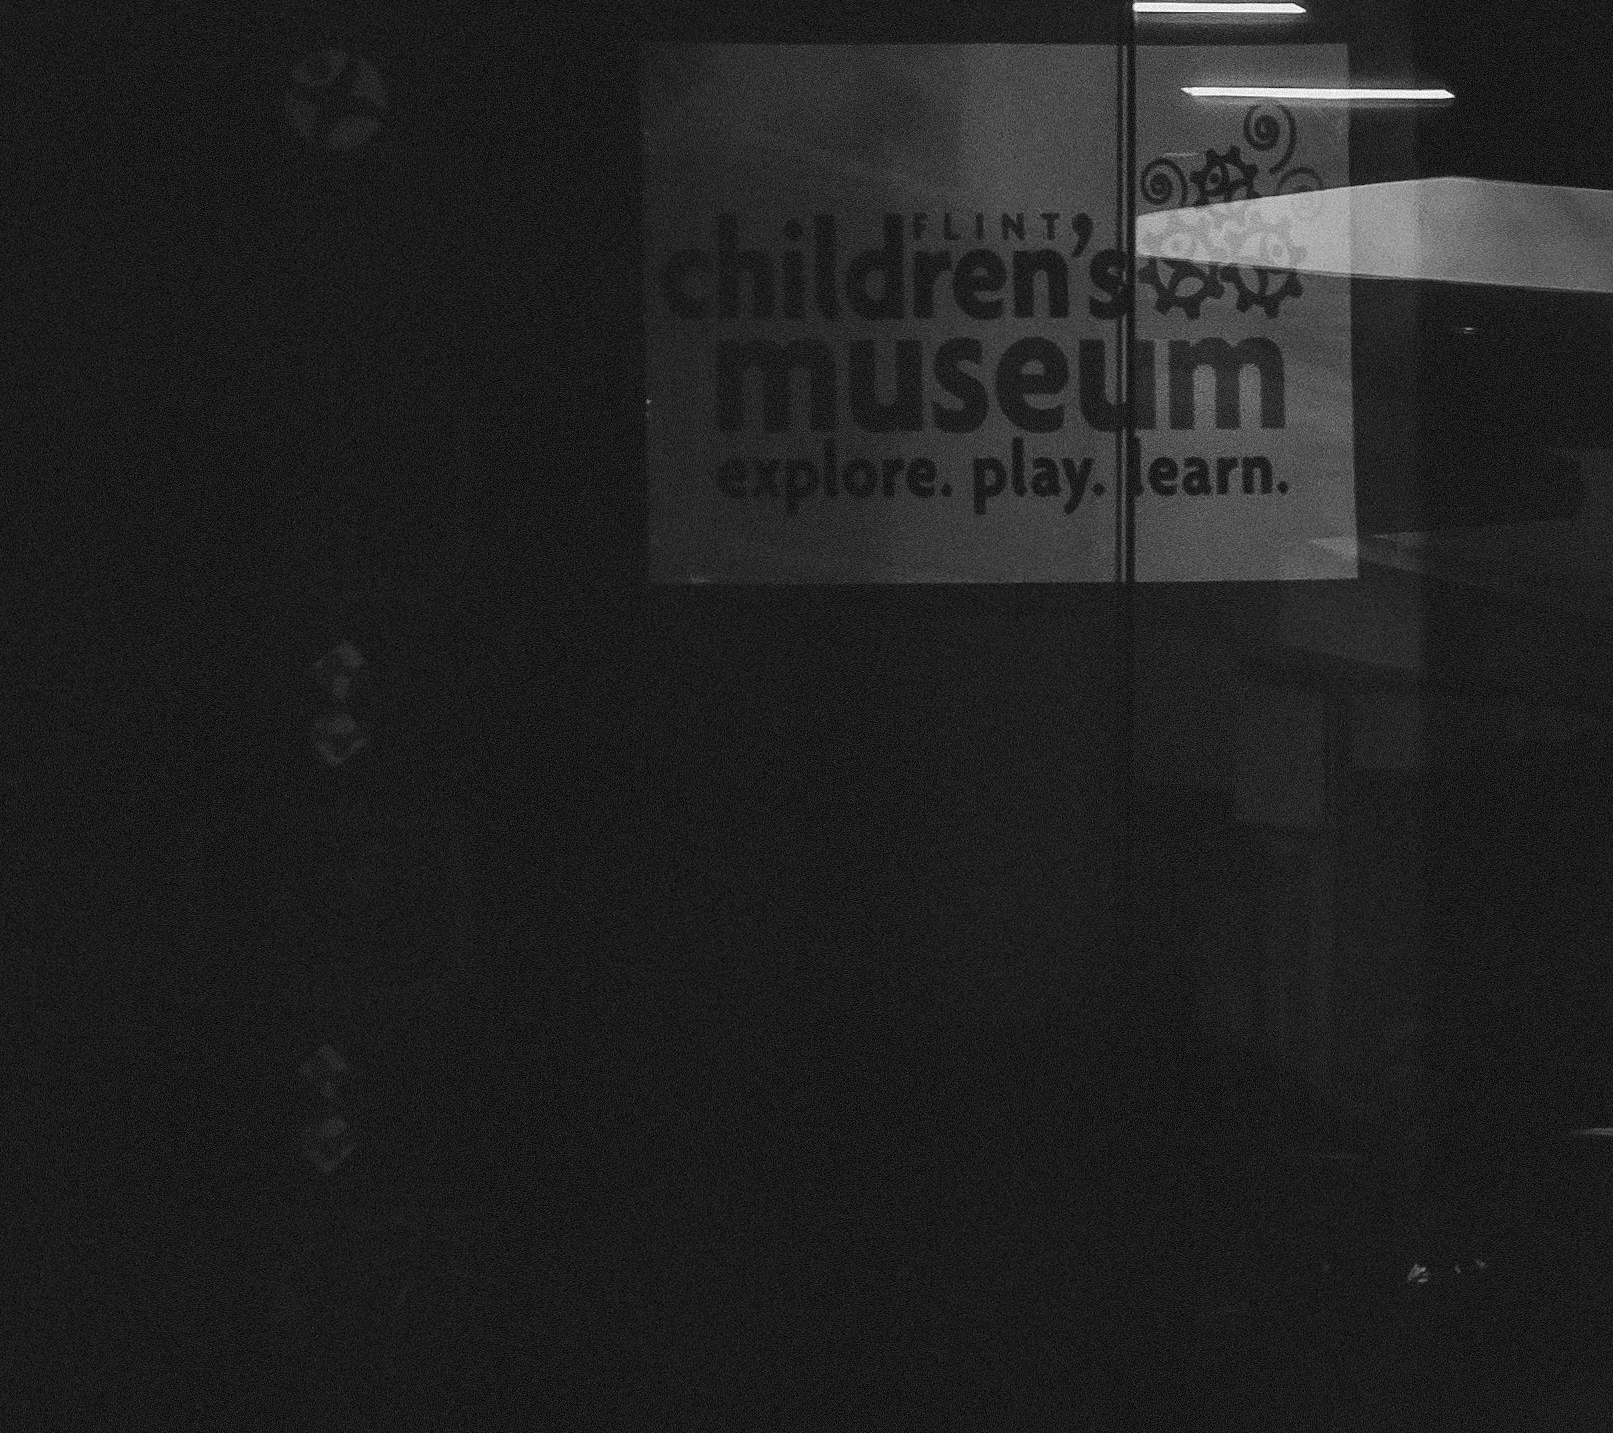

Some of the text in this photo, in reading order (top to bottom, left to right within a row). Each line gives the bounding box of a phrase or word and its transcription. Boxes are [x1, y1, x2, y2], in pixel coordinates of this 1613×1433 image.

[659, 211, 1133, 321] children's
[911, 212, 1061, 241] FLINT
[714, 334, 1286, 434] museum
[715, 438, 953, 517] explore.
[973, 438, 1106, 515] play.
